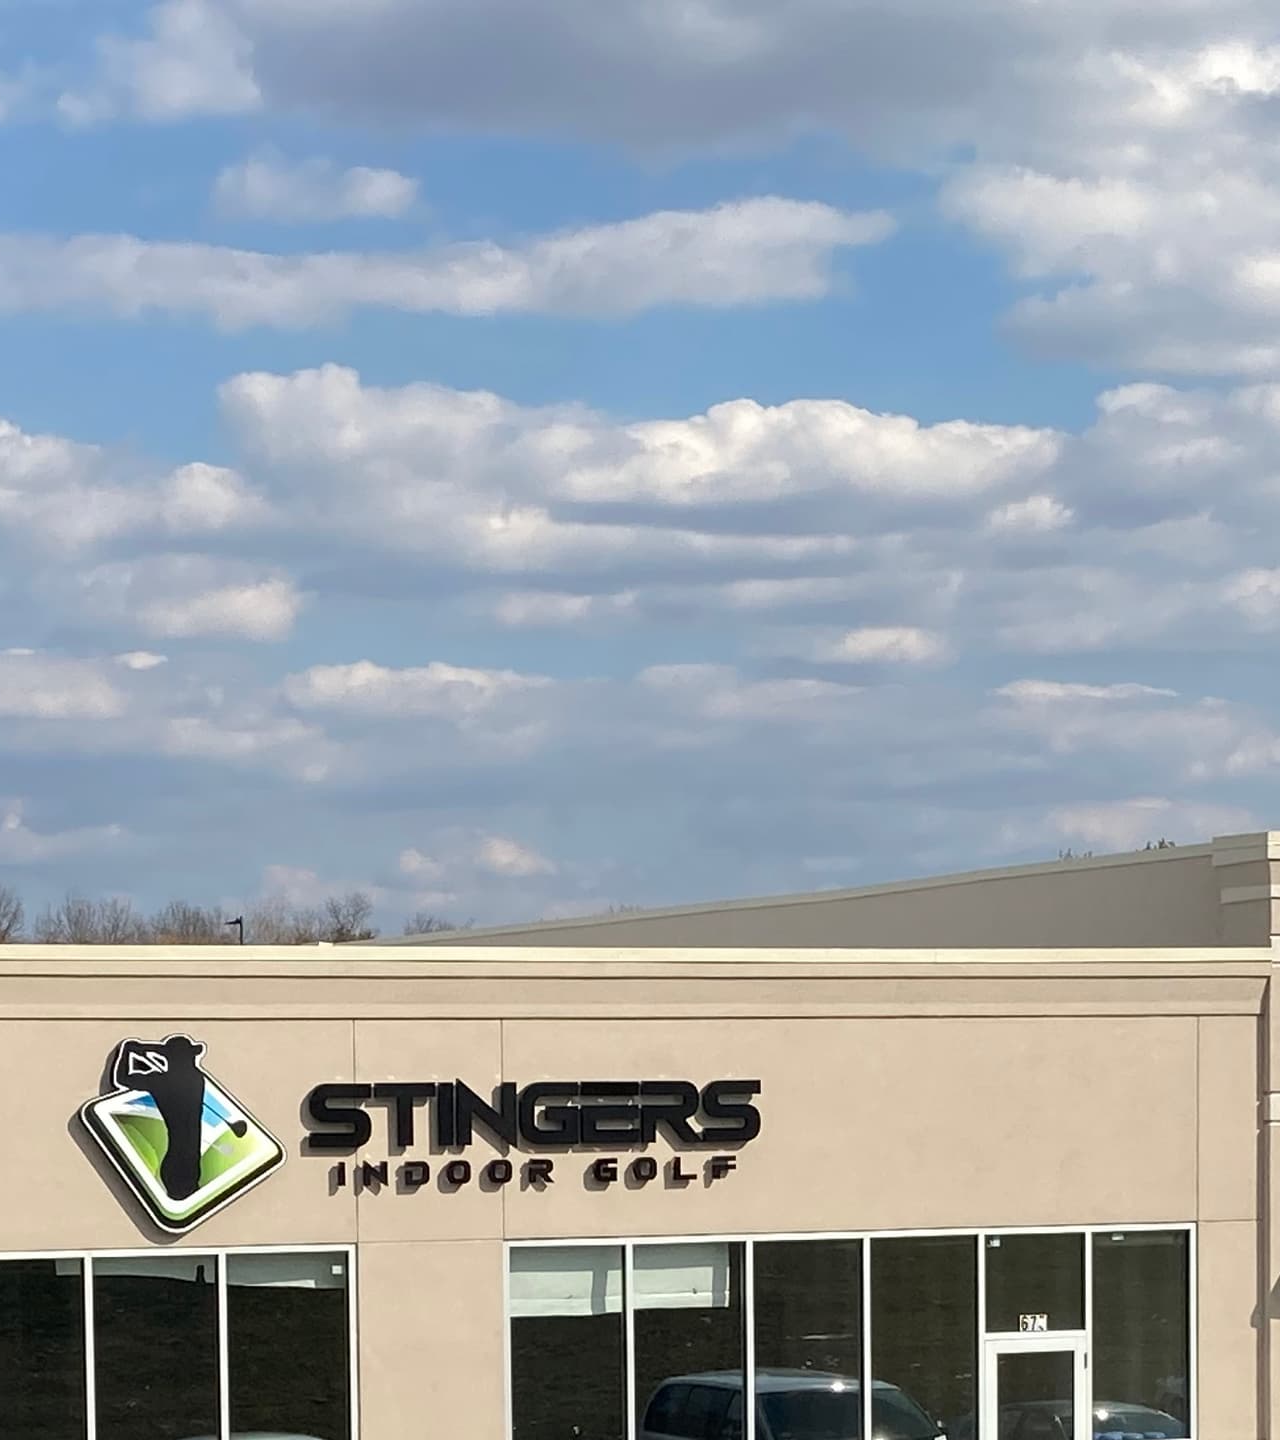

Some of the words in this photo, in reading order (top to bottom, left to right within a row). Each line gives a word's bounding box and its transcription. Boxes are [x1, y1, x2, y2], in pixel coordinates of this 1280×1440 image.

[308, 1078, 761, 1148] STINGERS
[336, 1158, 555, 1187] INDOOR
[593, 1155, 737, 1183] GOLF
